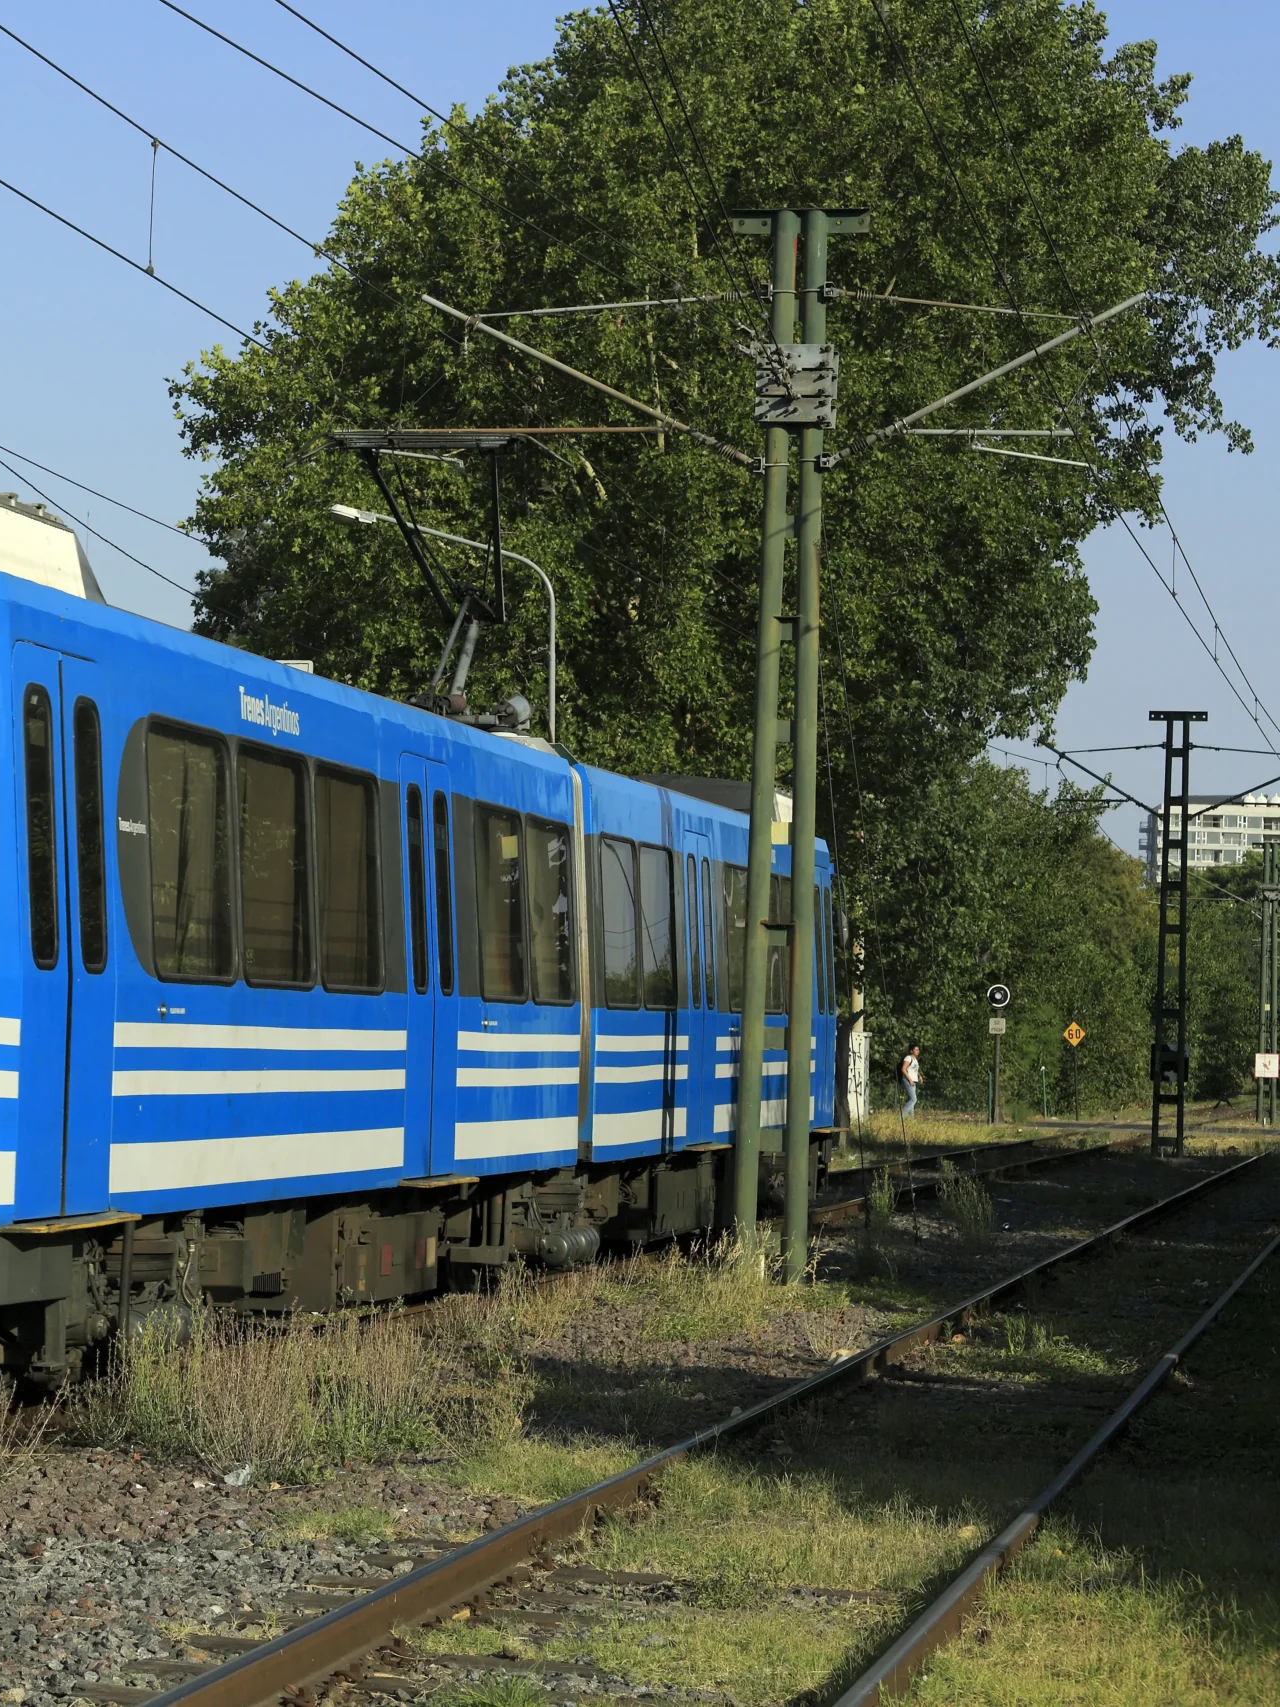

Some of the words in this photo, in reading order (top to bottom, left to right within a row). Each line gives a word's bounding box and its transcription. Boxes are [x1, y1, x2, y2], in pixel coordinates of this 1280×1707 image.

[238, 685, 265, 726] Trenes
[265, 693, 300, 737] Argentinos
[1067, 1028, 1081, 1040] 60
